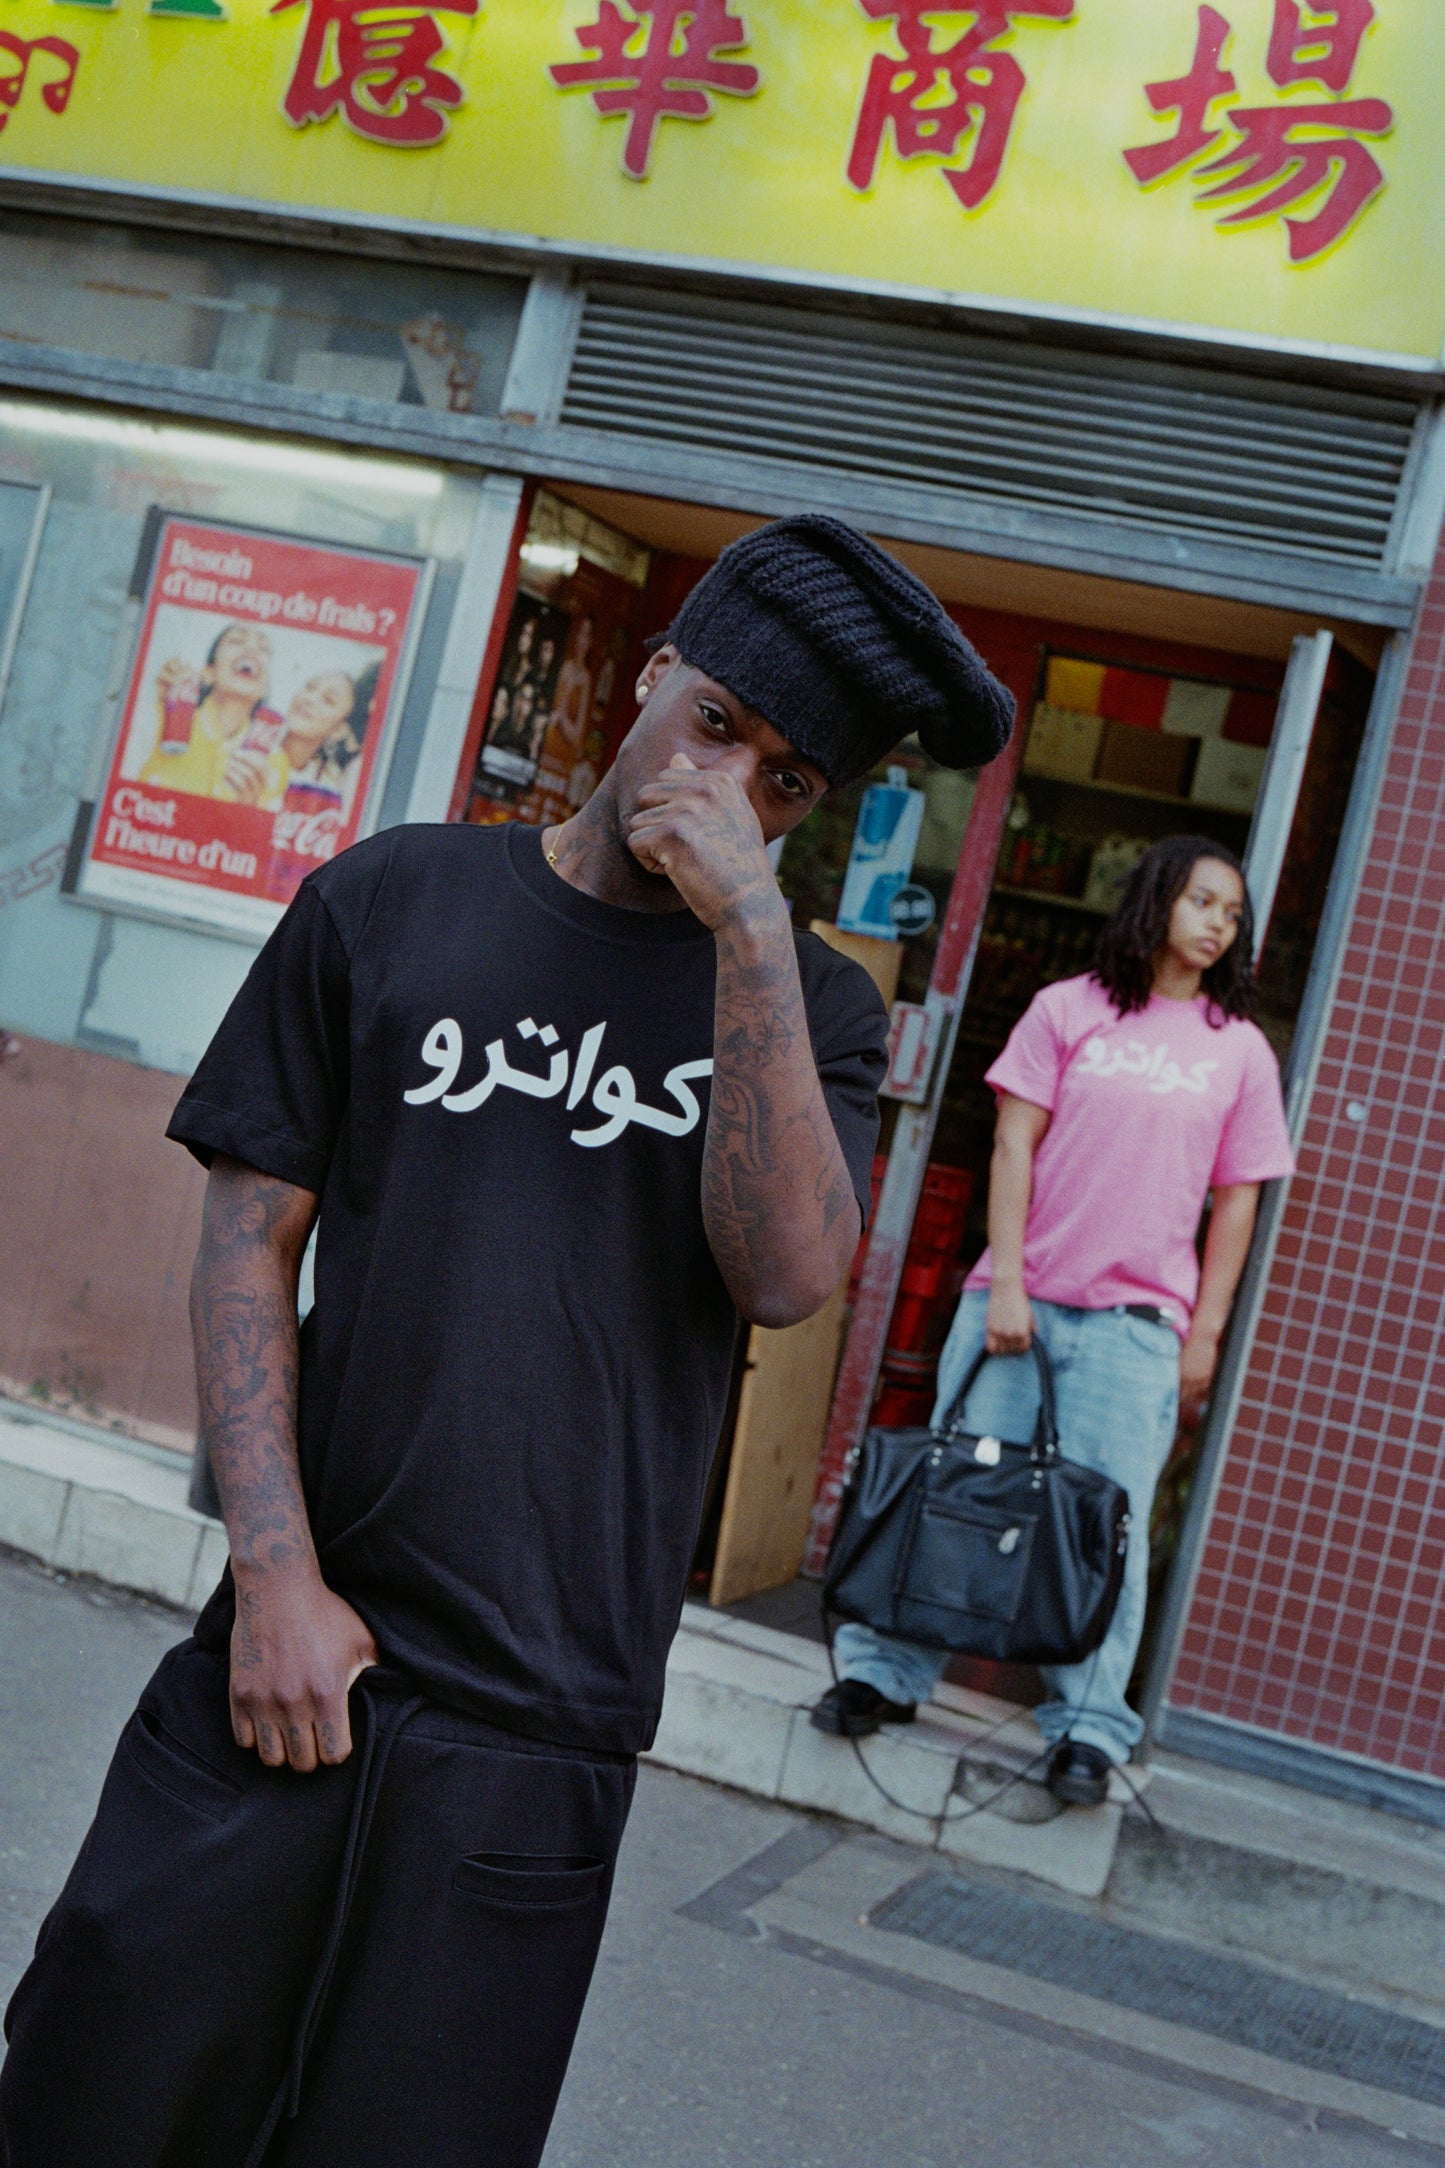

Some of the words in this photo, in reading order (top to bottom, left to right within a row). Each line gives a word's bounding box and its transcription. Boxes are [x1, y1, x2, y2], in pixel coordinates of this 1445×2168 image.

[168, 537, 253, 580] Besoin
[161, 570, 218, 604] d'un
[218, 584, 282, 620] coup
[282, 592, 318, 622] de
[317, 597, 376, 635] frais
[112, 787, 177, 828] C'est
[104, 816, 197, 864] l'heure
[197, 838, 258, 879] d'un
[404, 1018, 715, 1148] كواترو
